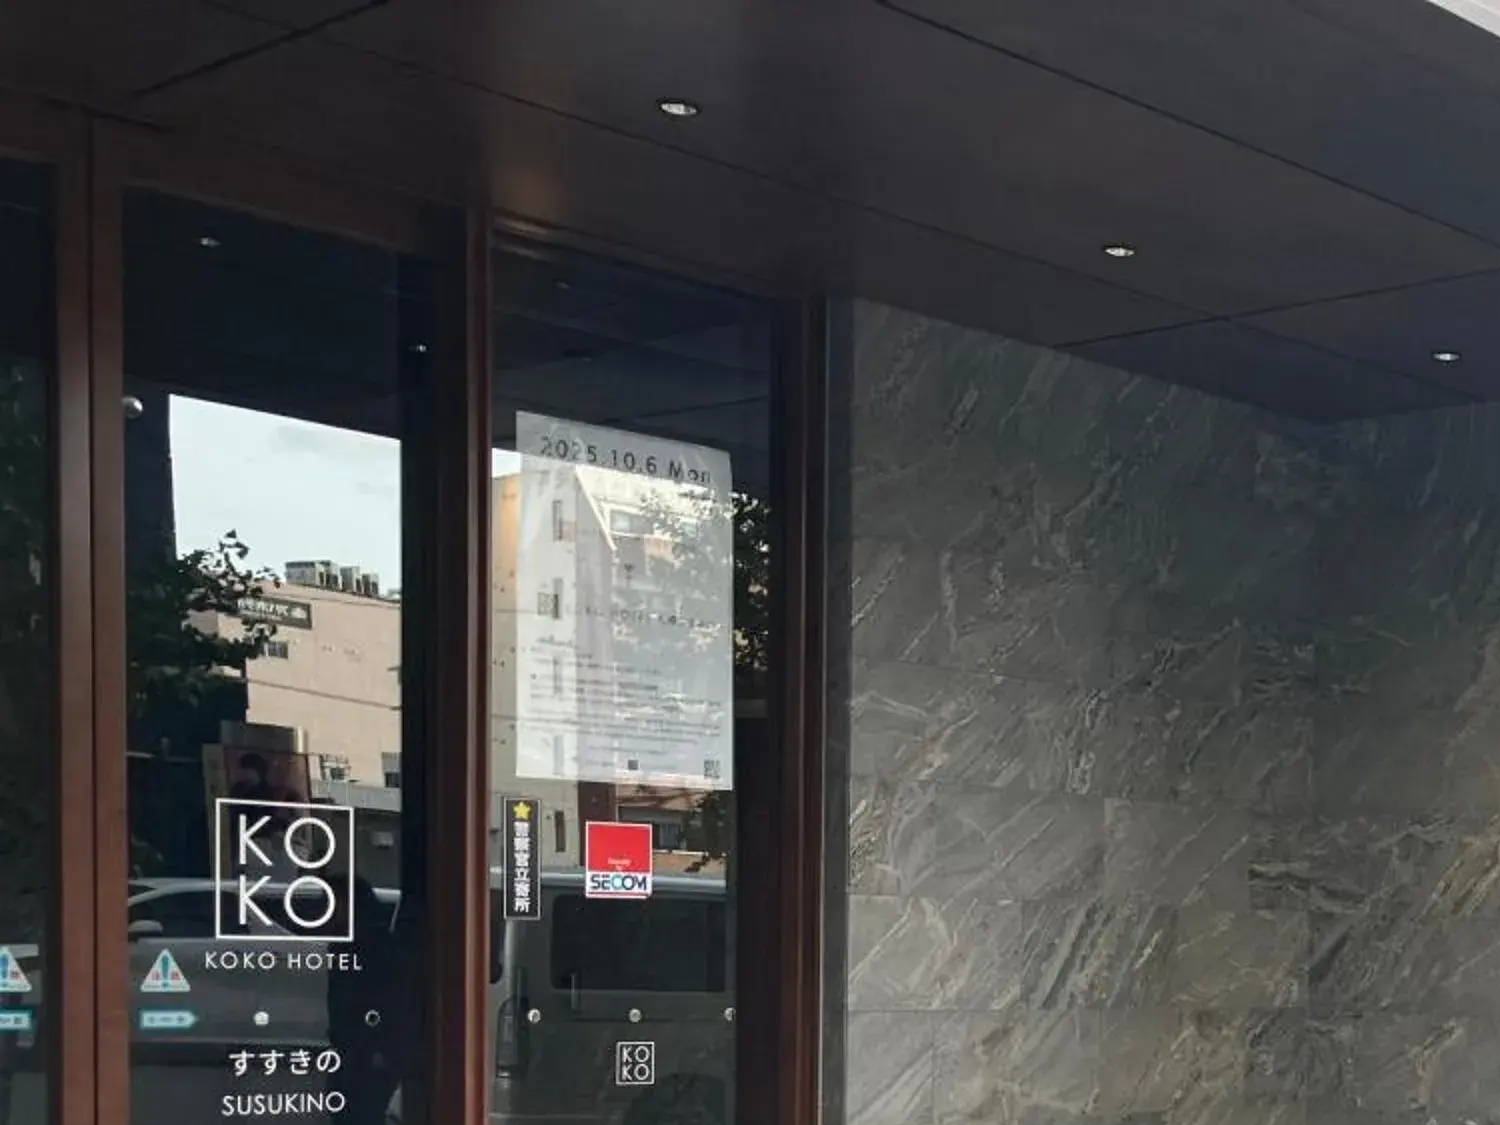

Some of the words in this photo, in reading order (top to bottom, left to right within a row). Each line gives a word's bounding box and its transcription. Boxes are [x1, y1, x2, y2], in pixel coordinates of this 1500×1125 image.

[239, 814, 336, 869] KO
[591, 874, 647, 891] SECOM
[239, 874, 336, 928] KO
[205, 952, 276, 969] KOKO
[287, 953, 363, 971] HOTEL
[228, 1049, 341, 1076] すすきの
[622, 1046, 650, 1062] KO
[622, 1063, 650, 1080] KO
[221, 1090, 346, 1116] SUSUKINO
